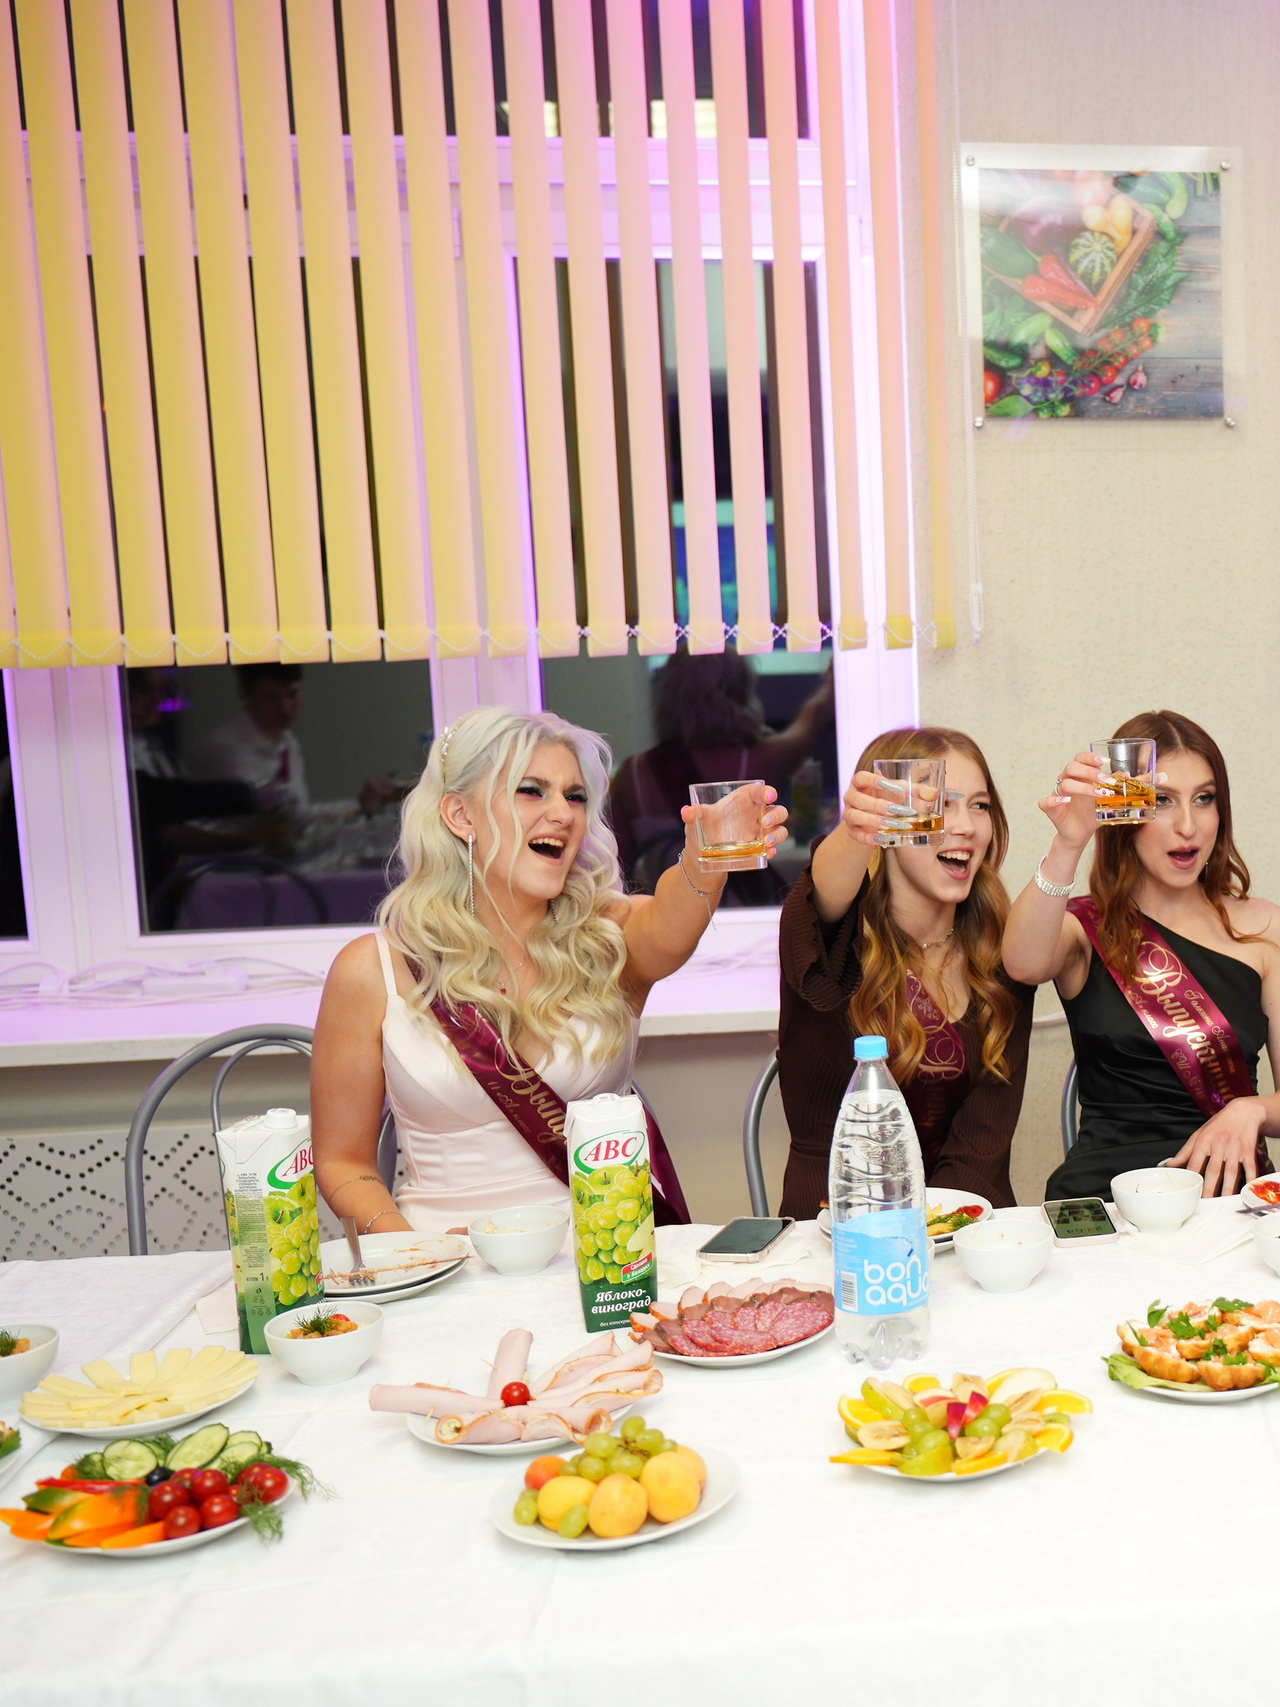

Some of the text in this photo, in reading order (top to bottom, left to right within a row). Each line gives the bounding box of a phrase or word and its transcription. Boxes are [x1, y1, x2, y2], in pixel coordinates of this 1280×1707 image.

[863, 1255, 922, 1285] bon
[591, 1295, 652, 1314] виноград
[595, 1288, 647, 1303] Яблоко-
